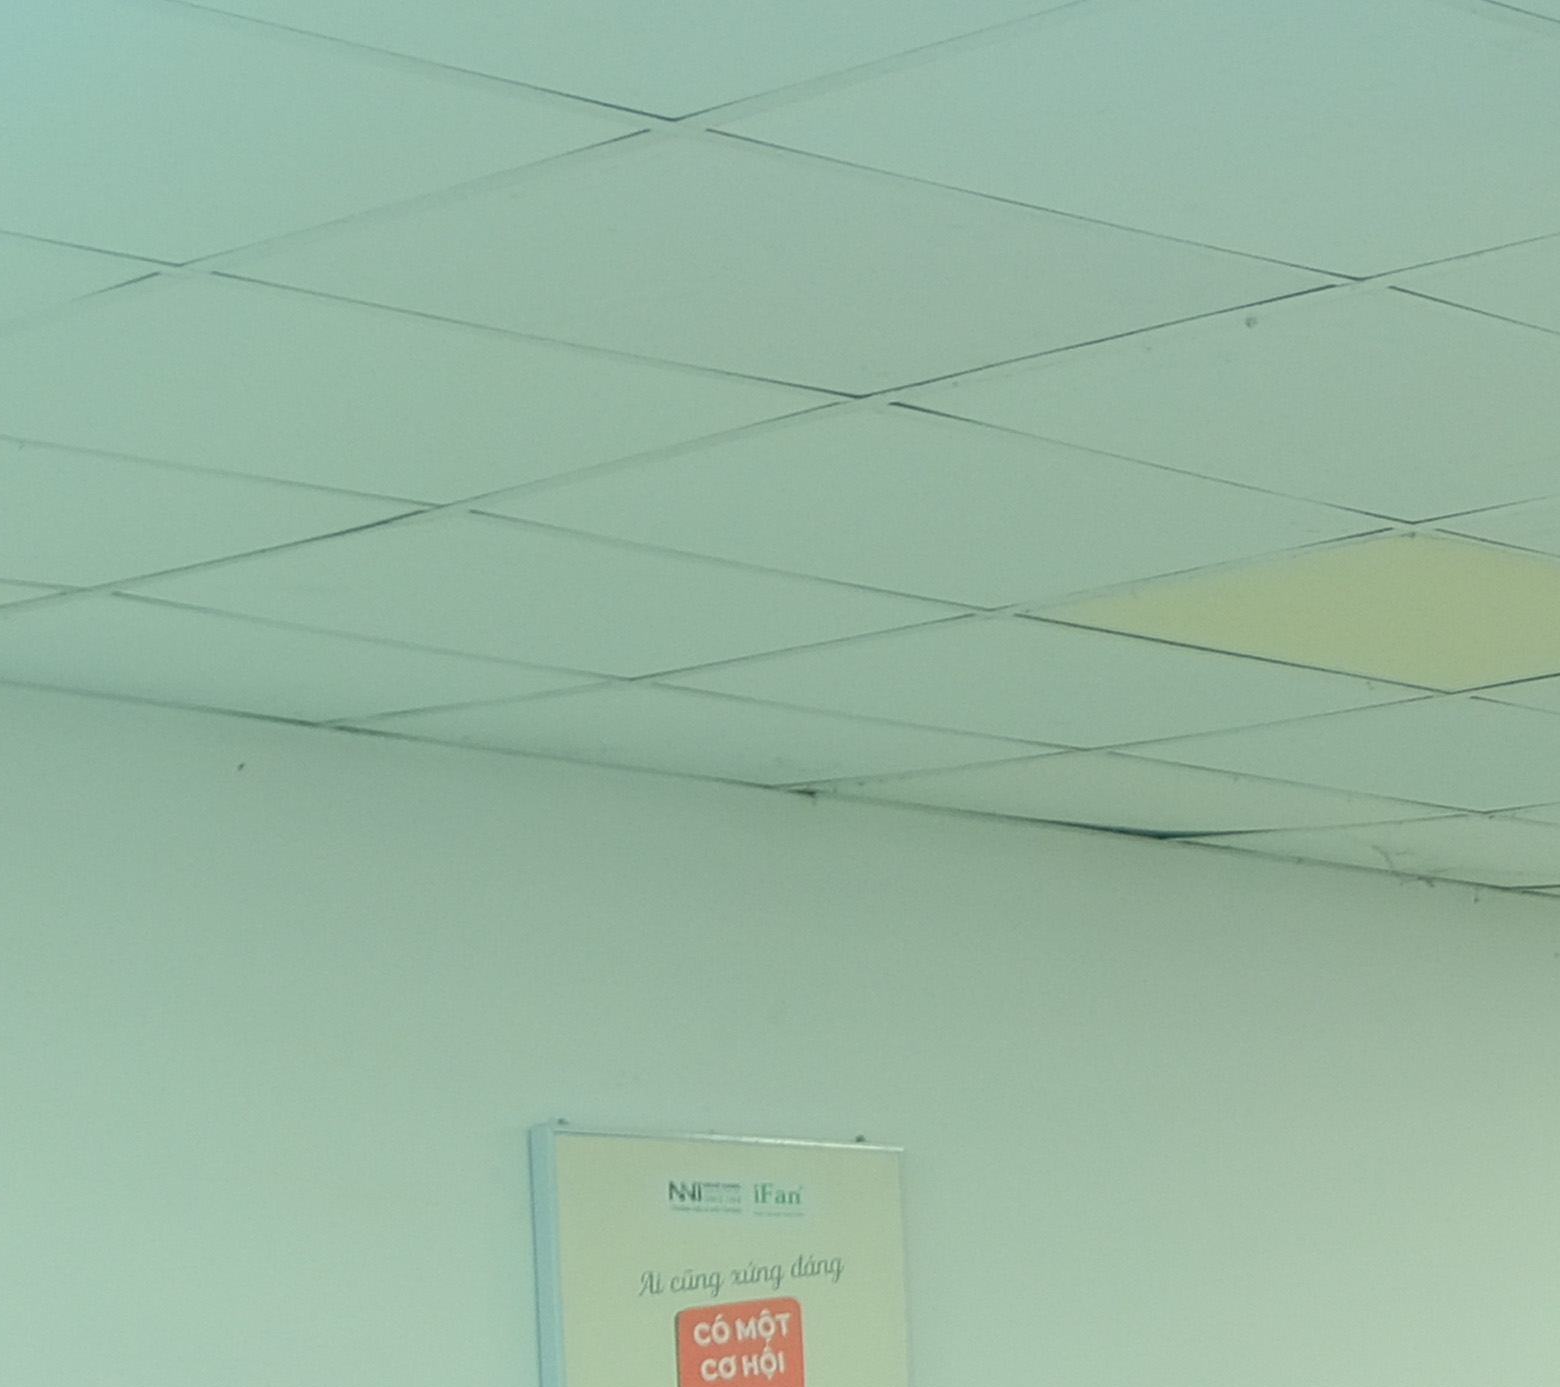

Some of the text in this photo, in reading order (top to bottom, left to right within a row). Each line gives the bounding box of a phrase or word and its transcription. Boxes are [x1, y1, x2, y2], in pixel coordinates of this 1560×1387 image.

[754, 1183, 802, 1205] iFan
[670, 1268, 724, 1297] cũng
[791, 1254, 845, 1284] đáng
[693, 1308, 792, 1347] CÓ MỘT
[700, 1347, 785, 1382] CƠ HỘI
